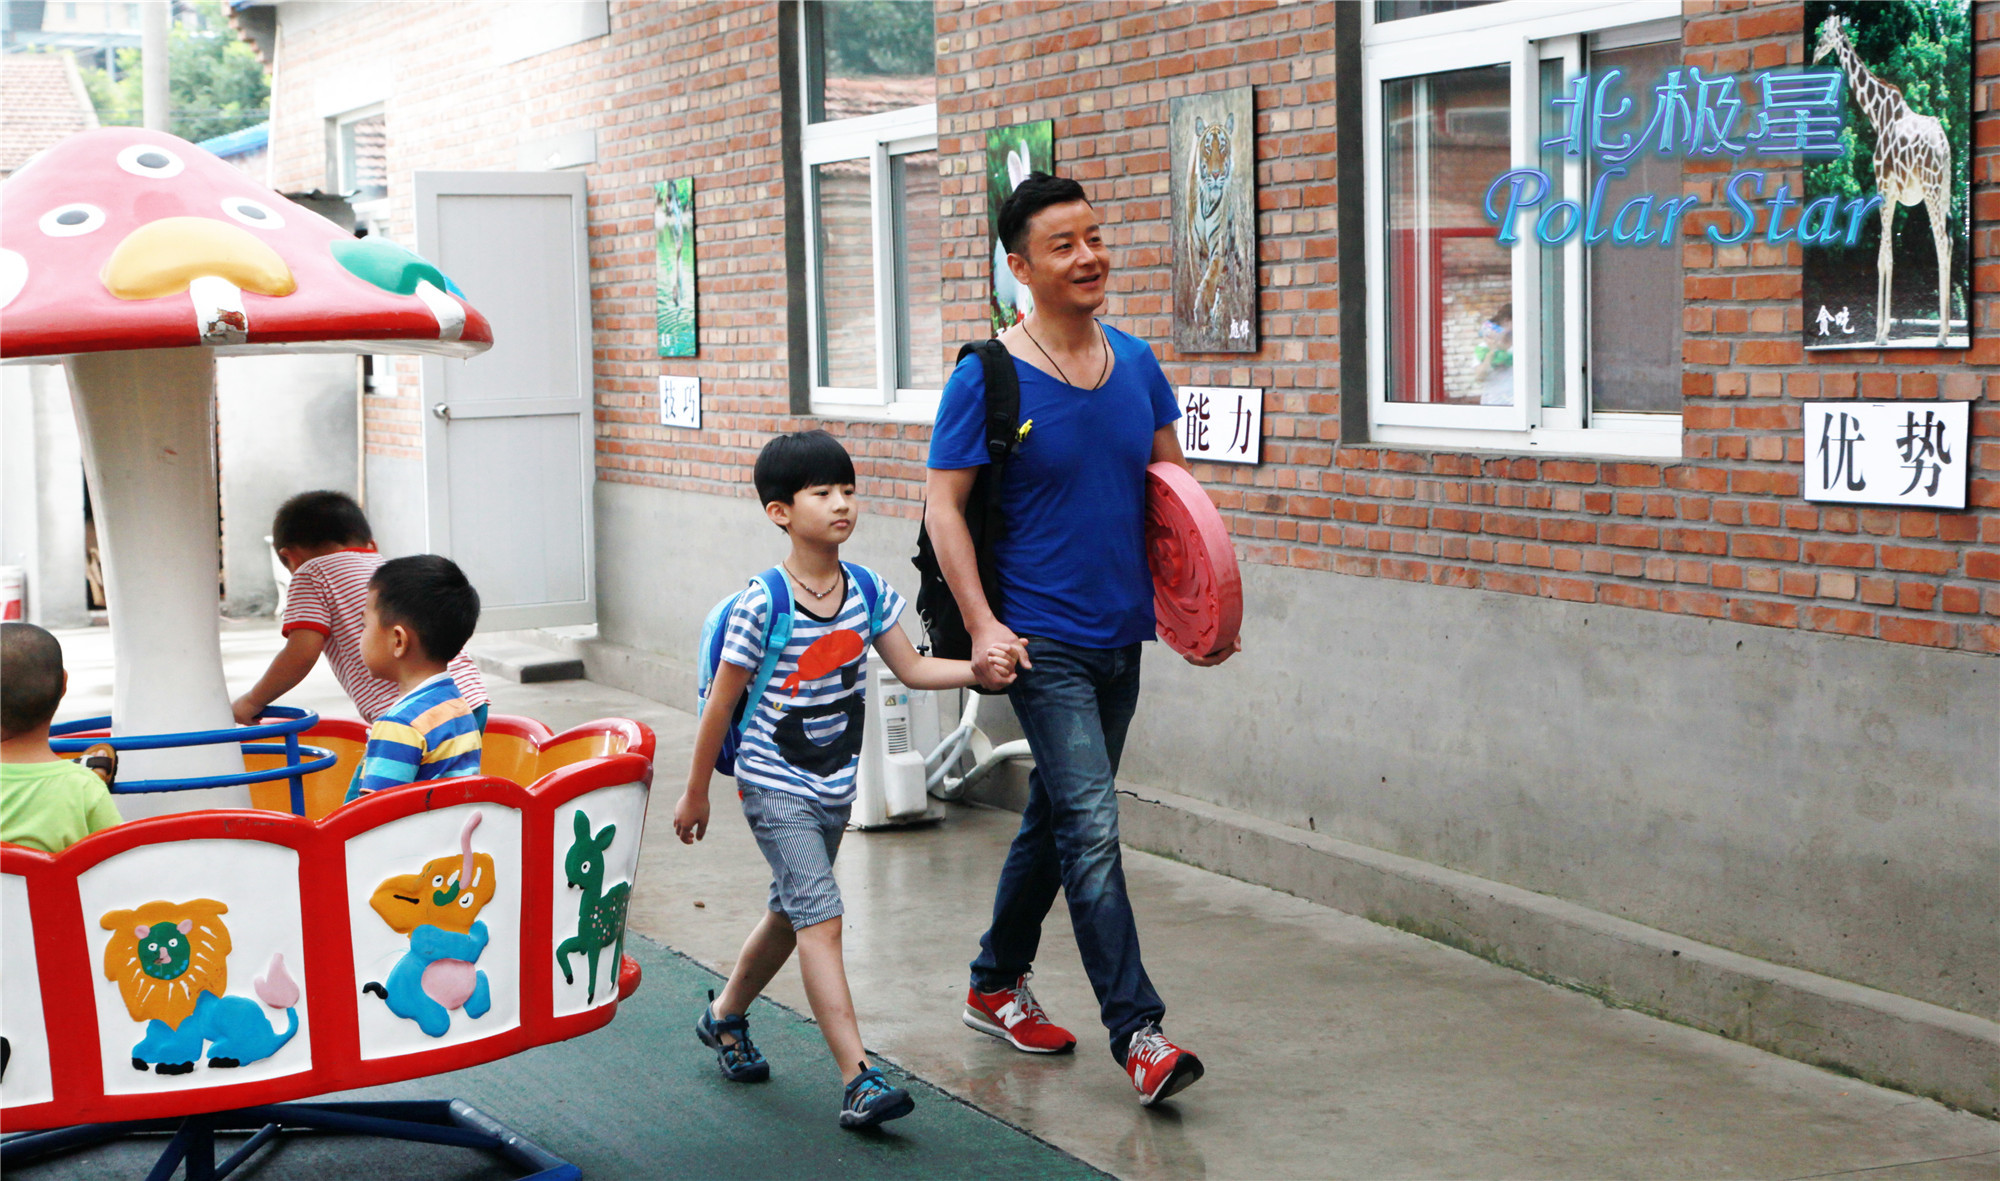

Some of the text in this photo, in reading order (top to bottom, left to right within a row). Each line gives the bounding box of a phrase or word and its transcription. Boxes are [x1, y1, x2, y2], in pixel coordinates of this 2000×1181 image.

[664, 379, 697, 423] 技巧
[1185, 392, 1252, 455] 能力
[1816, 410, 1953, 498] 优势
